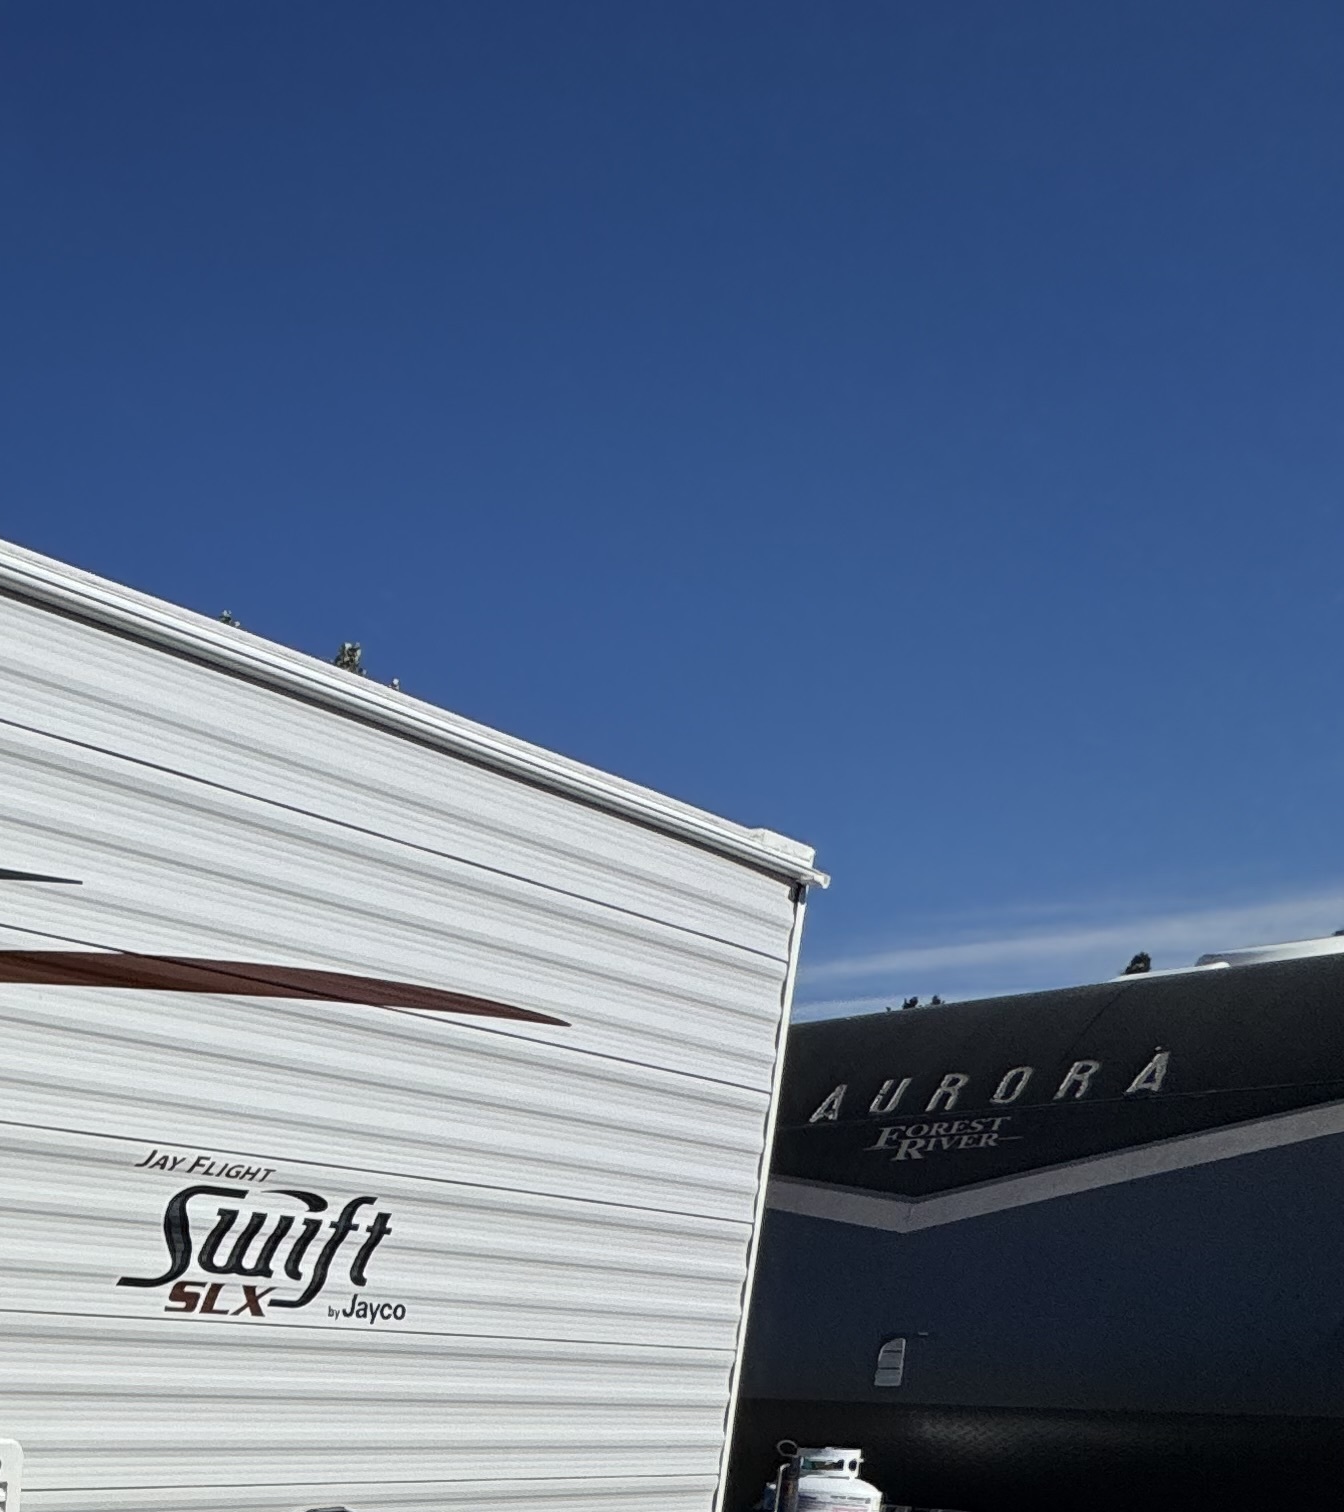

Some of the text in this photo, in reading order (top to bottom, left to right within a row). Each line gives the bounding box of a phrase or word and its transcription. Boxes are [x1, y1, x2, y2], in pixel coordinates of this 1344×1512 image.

[808, 1049, 1171, 1124] AURORA
[867, 1116, 1011, 1151] FOREST
[890, 1132, 1002, 1162] RIVER
[115, 1184, 393, 1309] Swift
[163, 1279, 279, 1318] SLX
[327, 1293, 407, 1325] by Jayco
